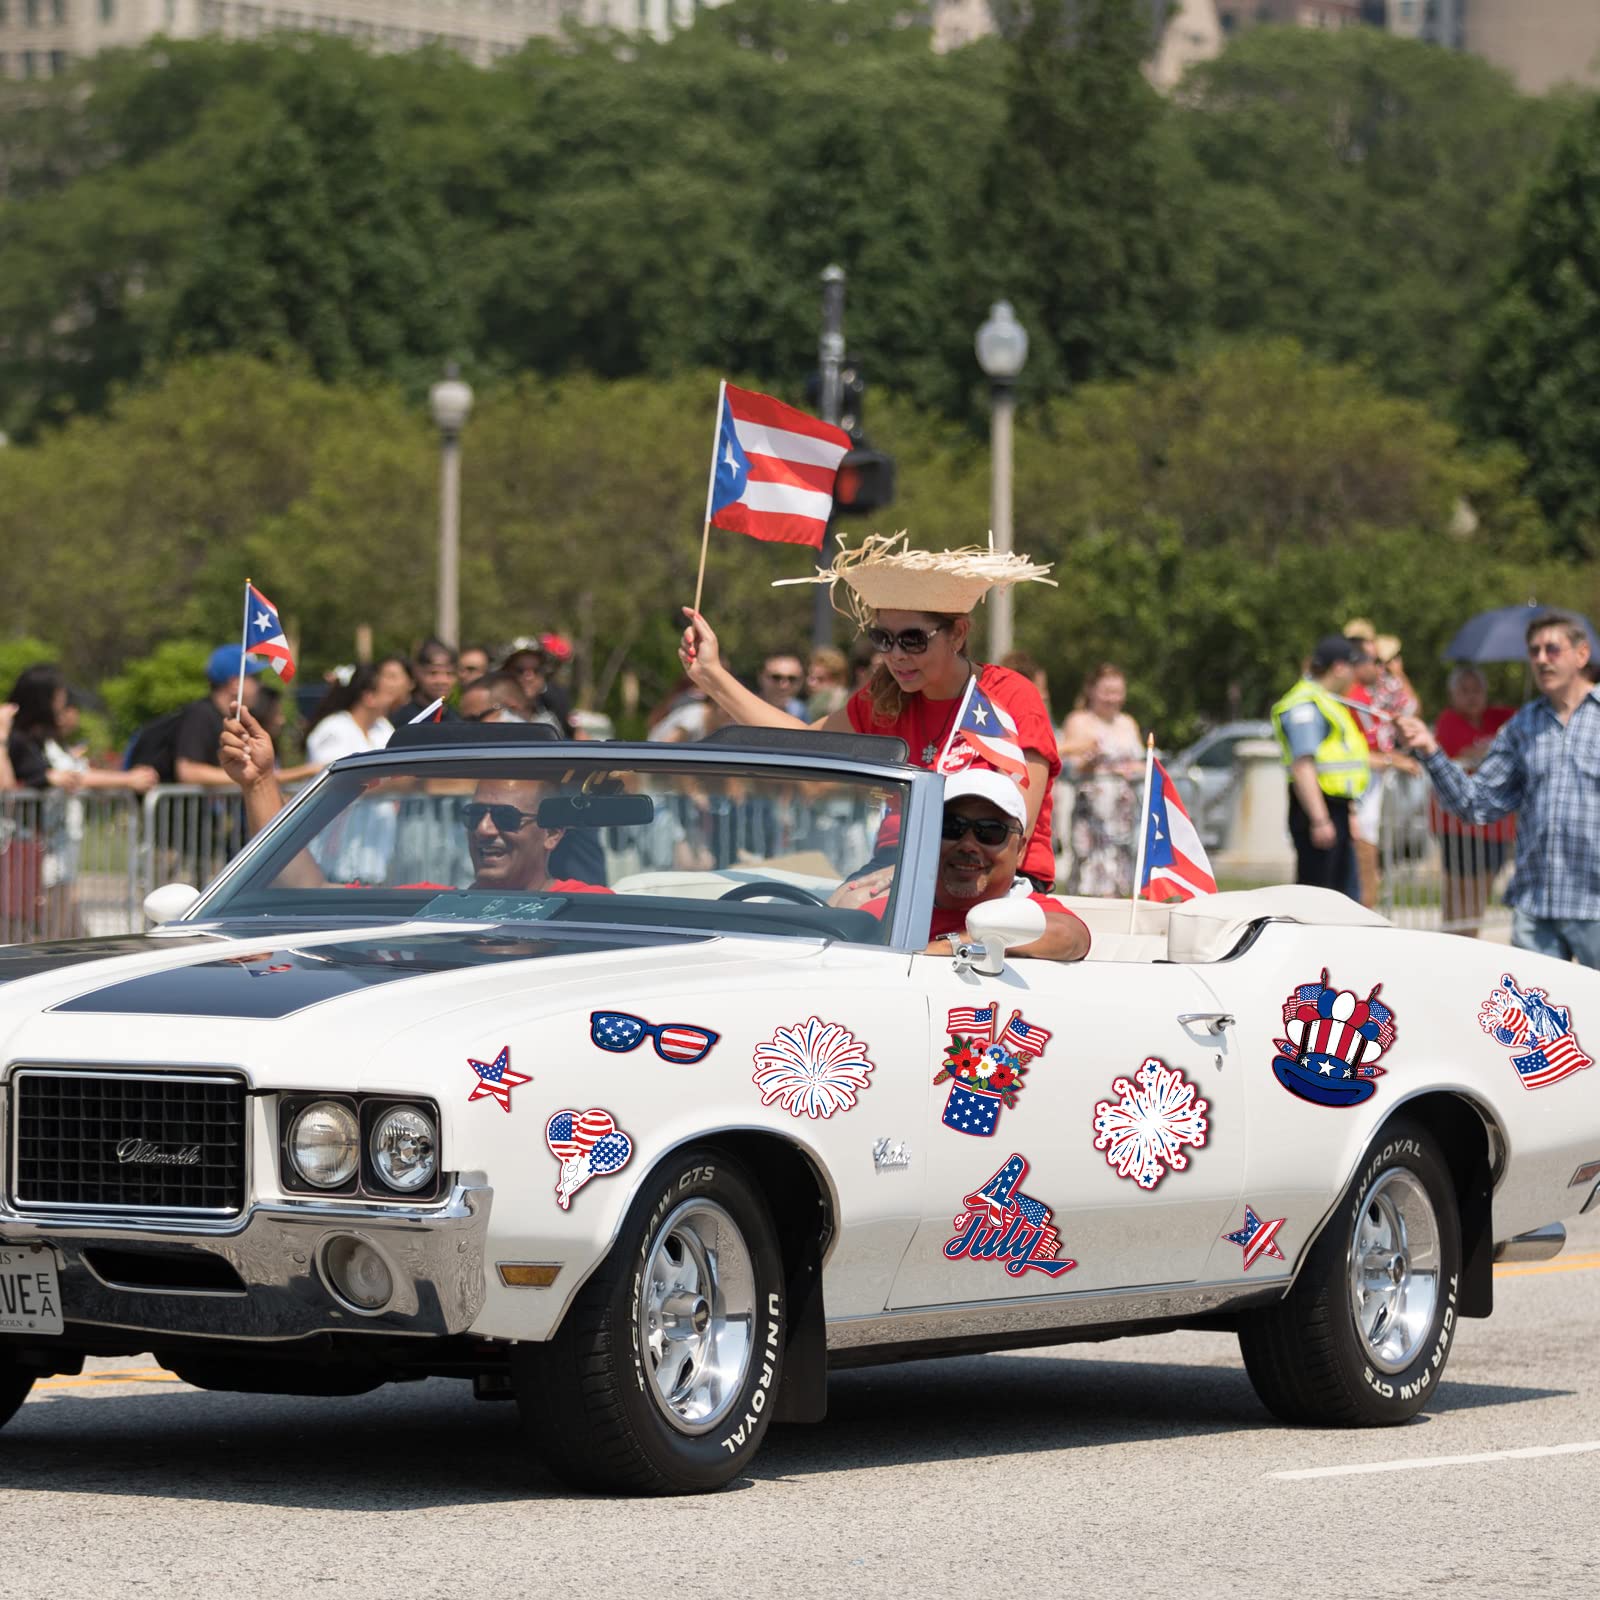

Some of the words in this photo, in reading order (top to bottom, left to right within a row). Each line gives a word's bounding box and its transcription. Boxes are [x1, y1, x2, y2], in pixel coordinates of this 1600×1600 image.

[641, 1189, 671, 1259] PAW
[678, 1166, 715, 1191] GTS
[965, 1154, 1025, 1227] 4
[1352, 1139, 1421, 1221] UNIROYAL
[944, 1215, 1074, 1275] July
[954, 1212, 972, 1230] of
[0, 1274, 37, 1314] VE
[1431, 1273, 1458, 1368] TIGER
[721, 1293, 779, 1453] UNIROYAL
[1364, 1366, 1394, 1398] GTS
[1400, 1368, 1430, 1400] PAW
